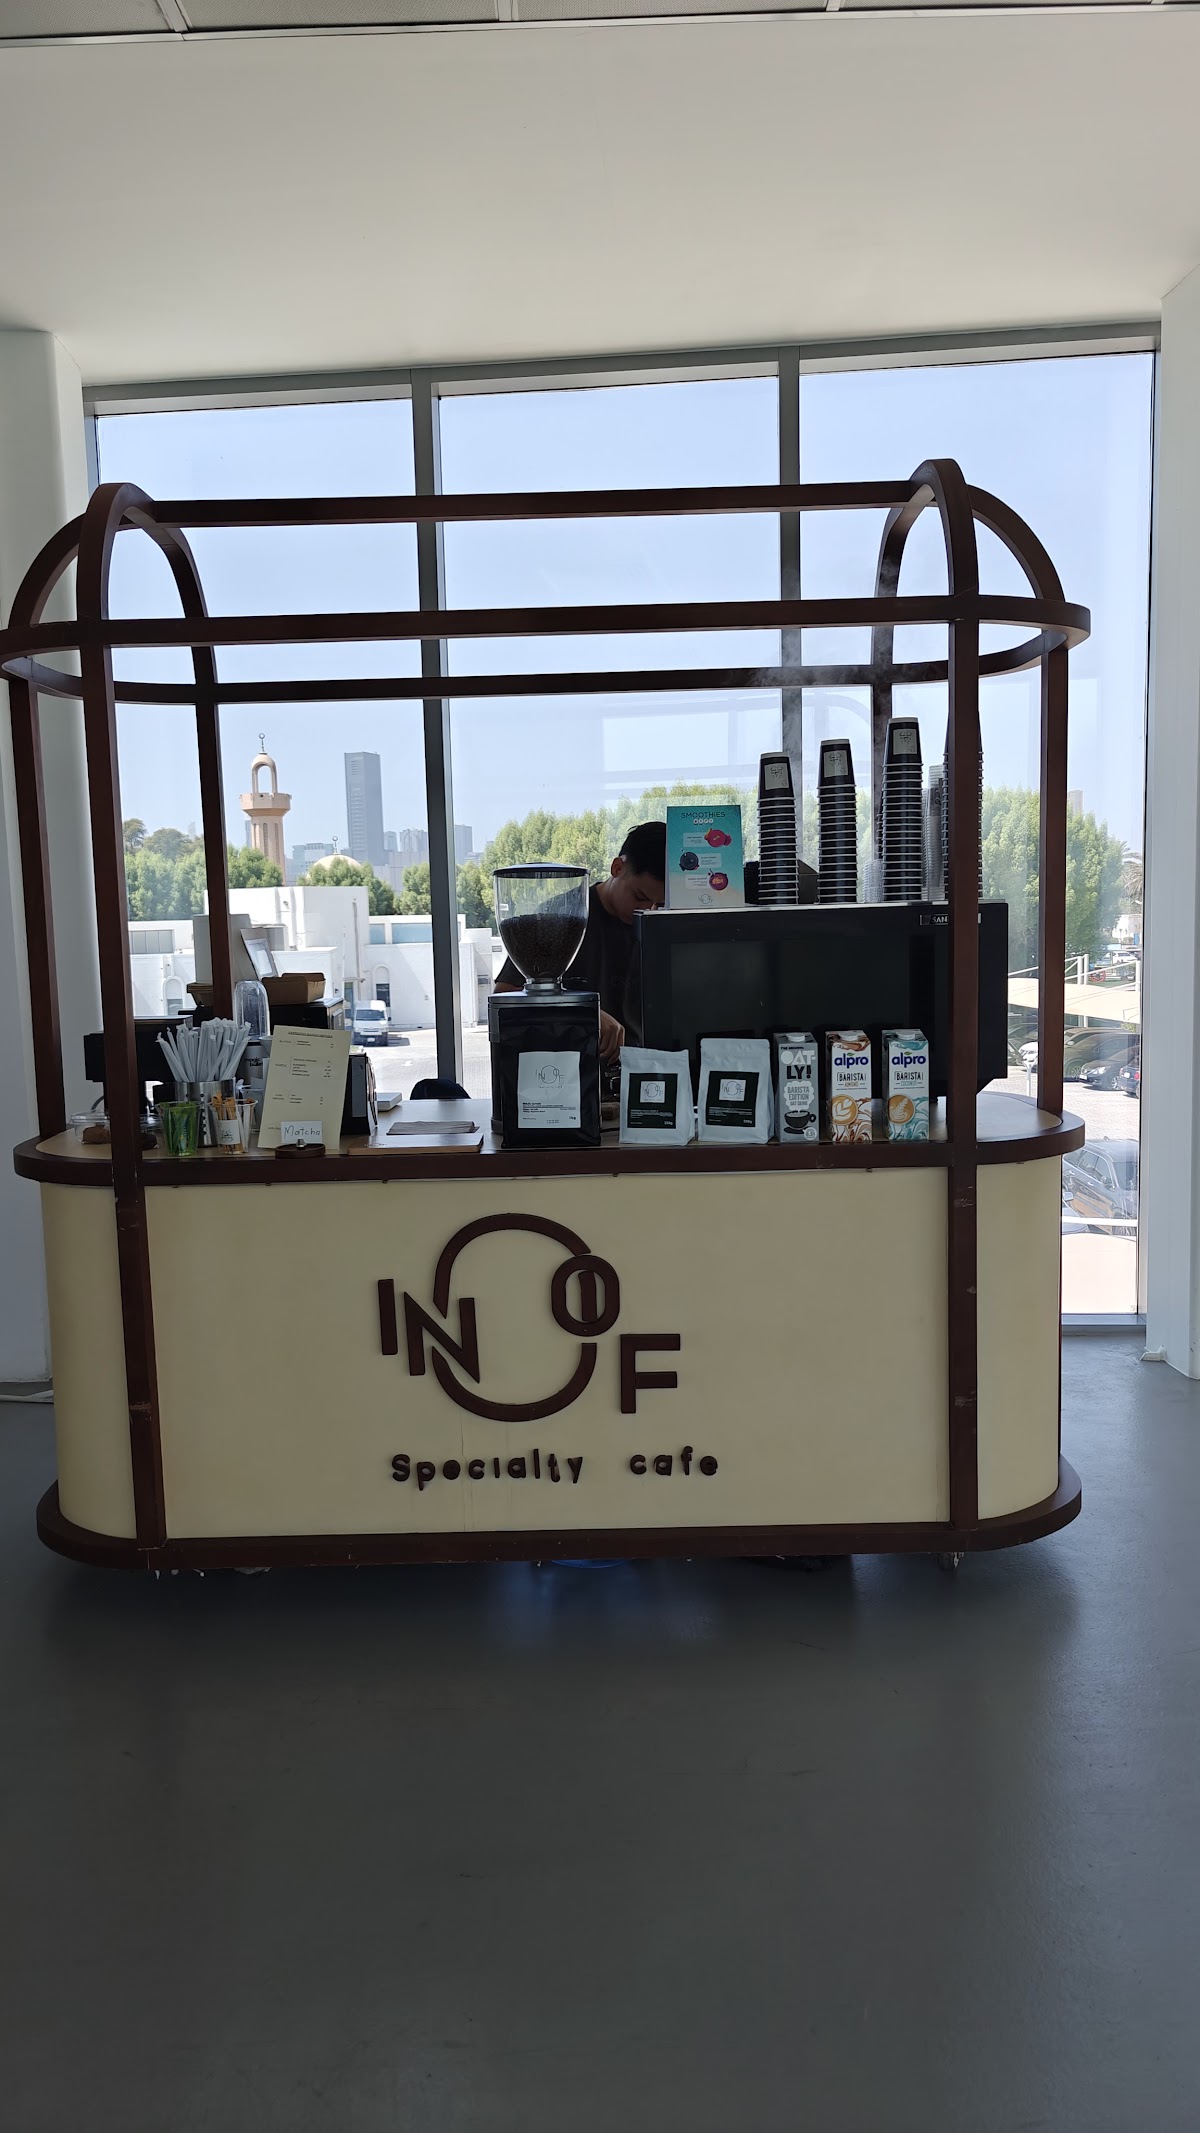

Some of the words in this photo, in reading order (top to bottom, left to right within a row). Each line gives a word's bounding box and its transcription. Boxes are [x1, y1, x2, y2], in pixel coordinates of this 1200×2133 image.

[834, 1053, 869, 1069] alpro
[891, 1051, 926, 1068] alpro
[786, 1064, 812, 1080] LY!
[839, 1073, 864, 1082] BARISTA
[896, 1072, 921, 1081] BARISTA
[788, 1093, 810, 1101] EDITION
[284, 1125, 321, 1139] Matcha
[391, 1448, 584, 1491] Specialty
[629, 1446, 719, 1477] cafe
